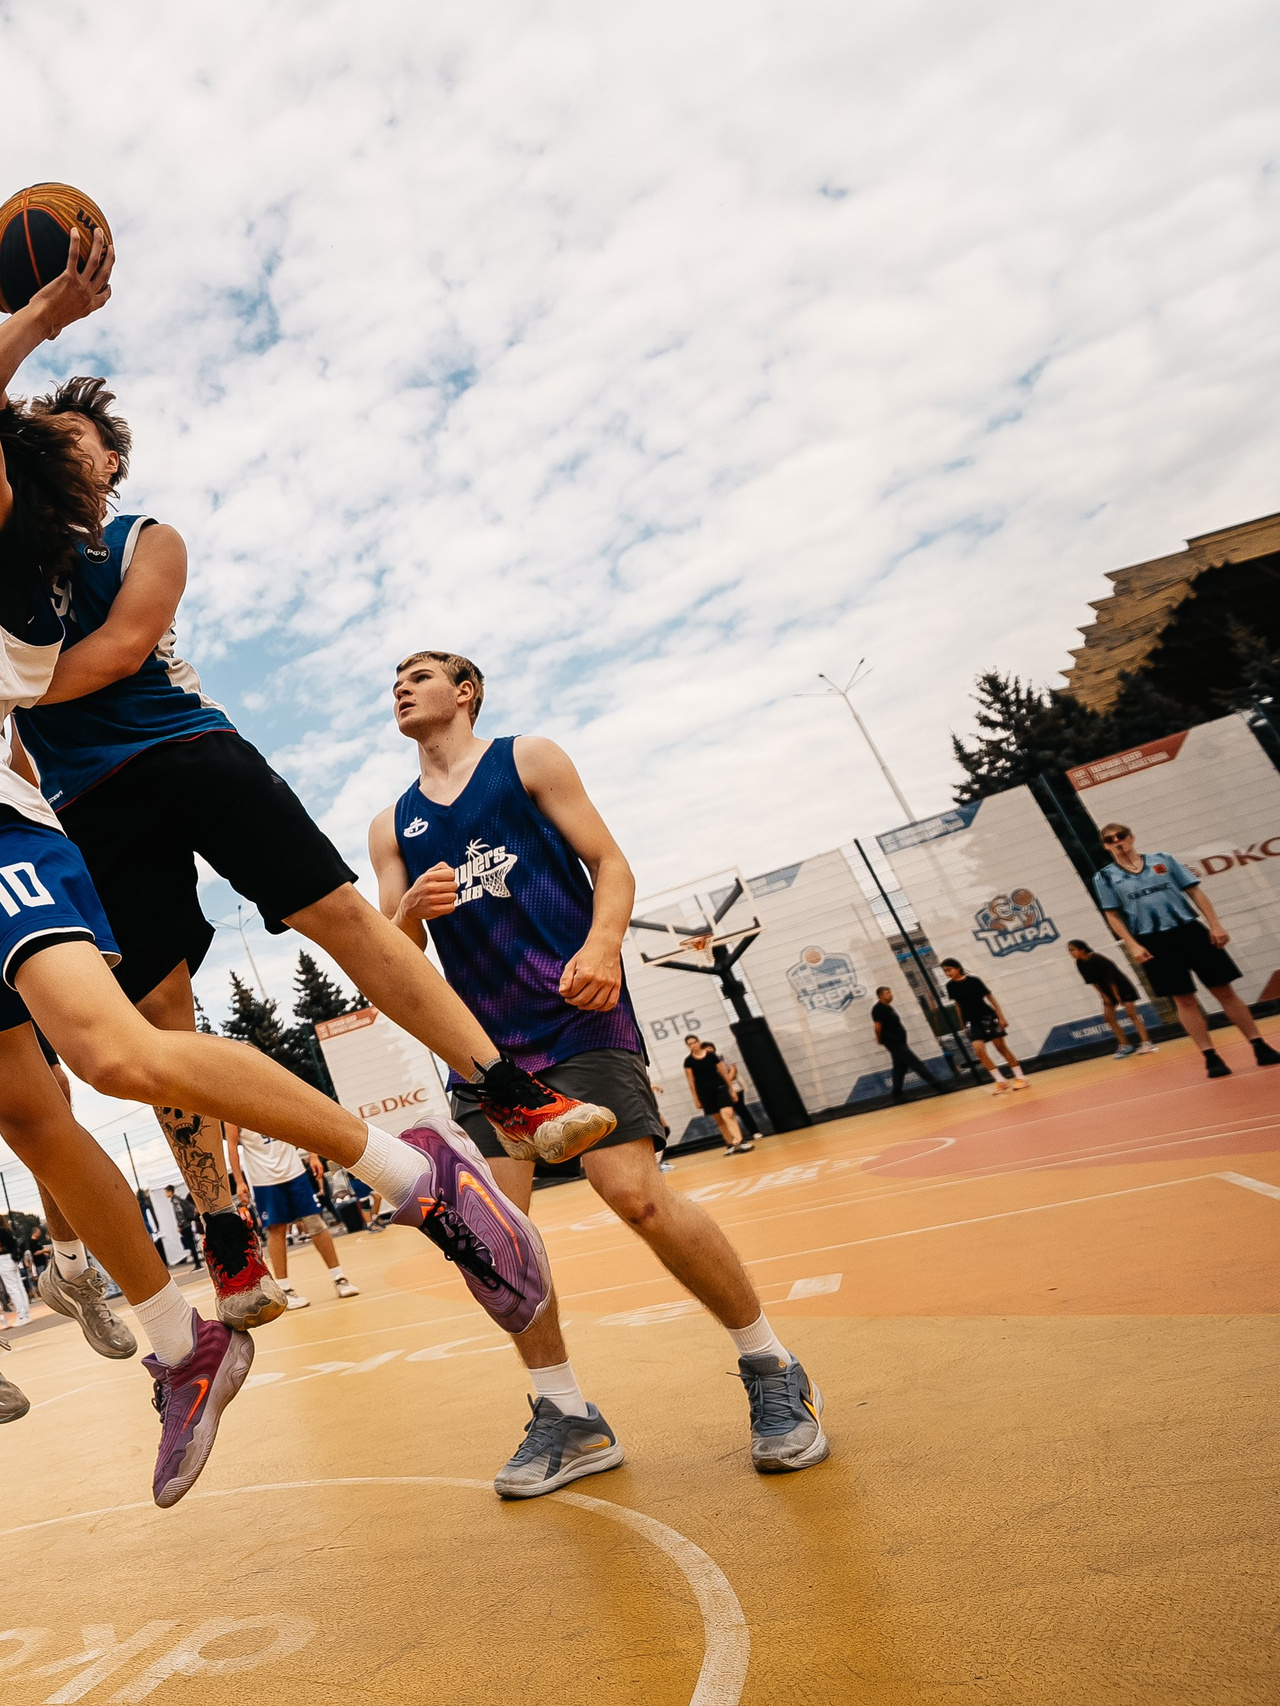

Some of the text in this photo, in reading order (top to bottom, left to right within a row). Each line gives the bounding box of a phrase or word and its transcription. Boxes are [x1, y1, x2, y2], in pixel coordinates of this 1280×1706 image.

[455, 845, 506, 889] yers
[1200, 836, 1280, 876] DKC
[454, 884, 483, 907] LUB
[650, 1010, 701, 1041] ВТБ
[381, 1087, 429, 1113] DKC
